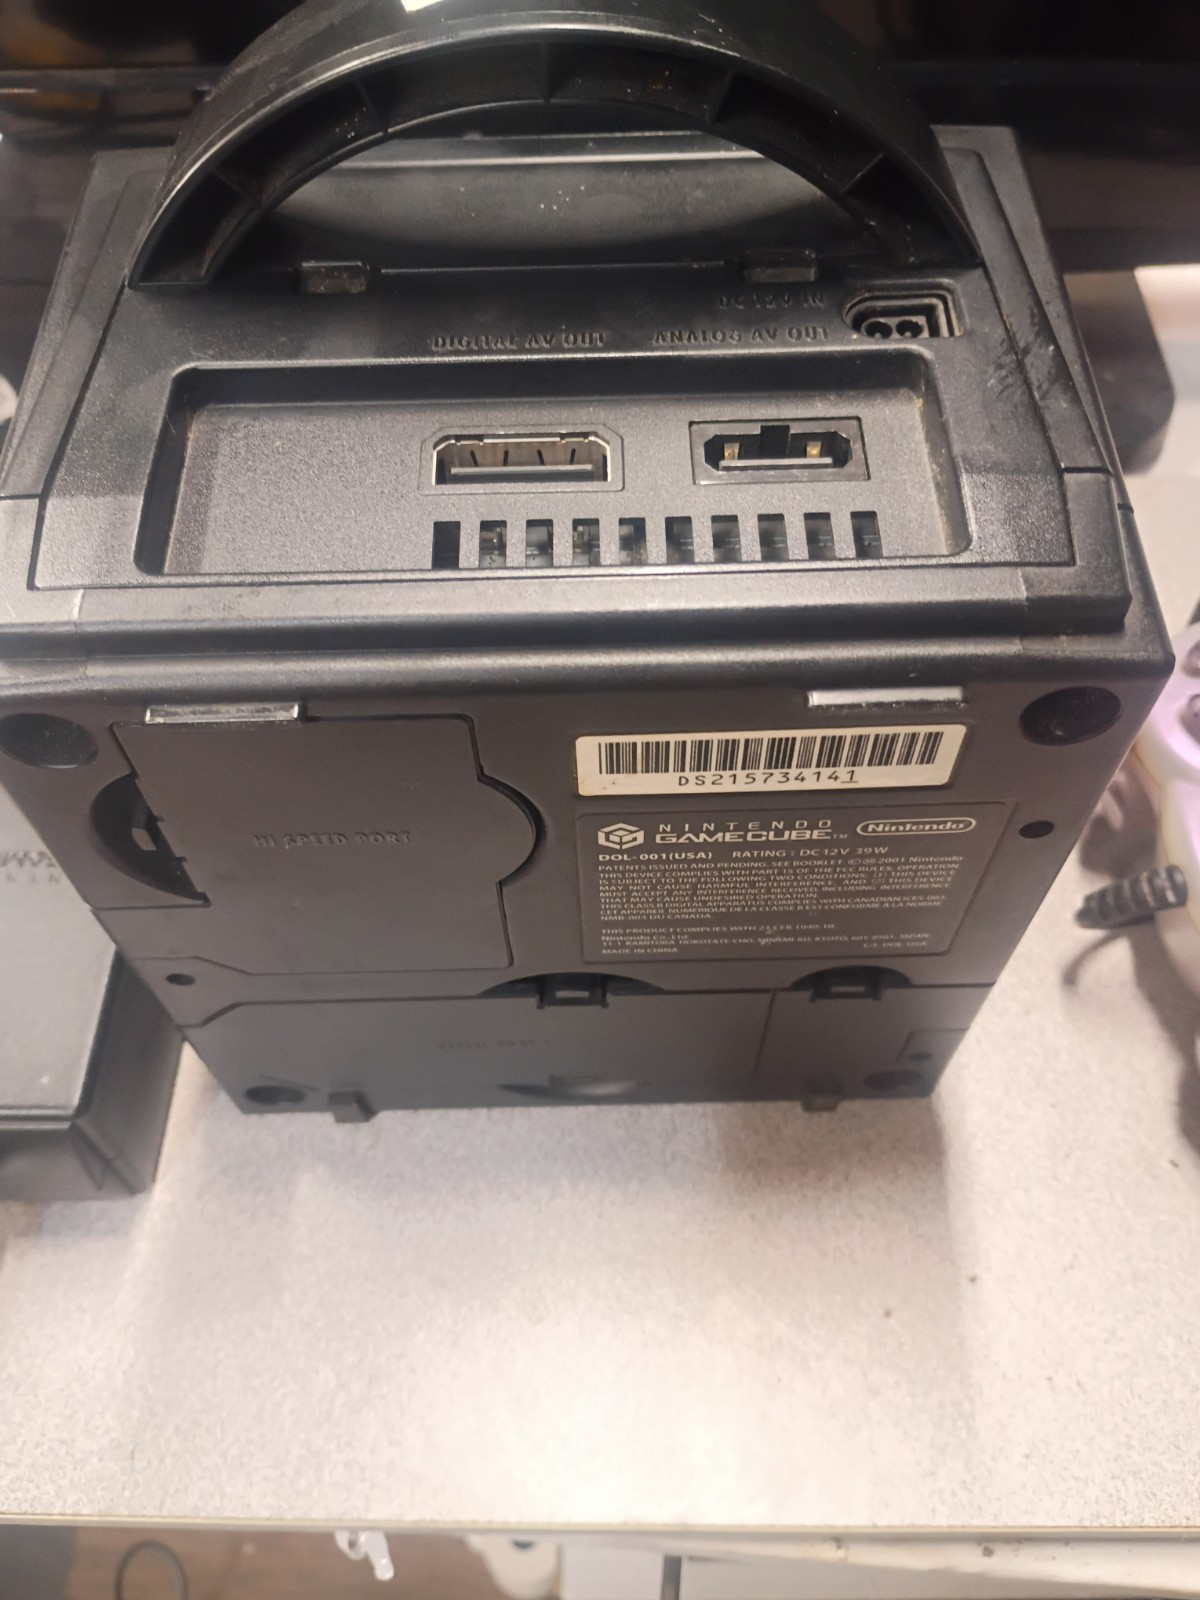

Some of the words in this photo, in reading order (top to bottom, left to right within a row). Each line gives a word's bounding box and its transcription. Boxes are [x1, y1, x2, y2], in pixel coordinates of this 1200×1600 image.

[432, 335, 520, 350] DIGITAL
[524, 333, 555, 350] AV
[561, 331, 606, 349] OUT
[652, 329, 743, 346] ANALOG
[750, 327, 780, 344] AV
[785, 325, 830, 343] OUT
[677, 769, 860, 787] DS215734141
[658, 819, 833, 833] NINTENDO
[283, 832, 349, 848] SPEED
[354, 830, 411, 845] PORT
[854, 846, 889, 855] 39W
[598, 851, 713, 862] DOL-001(USA)
[896, 863, 960, 871] OPERATION
[697, 882, 749, 890] HARMFUL
[696, 888, 768, 896] INTERFERENCE
[693, 894, 754, 902] UNDESIRED
